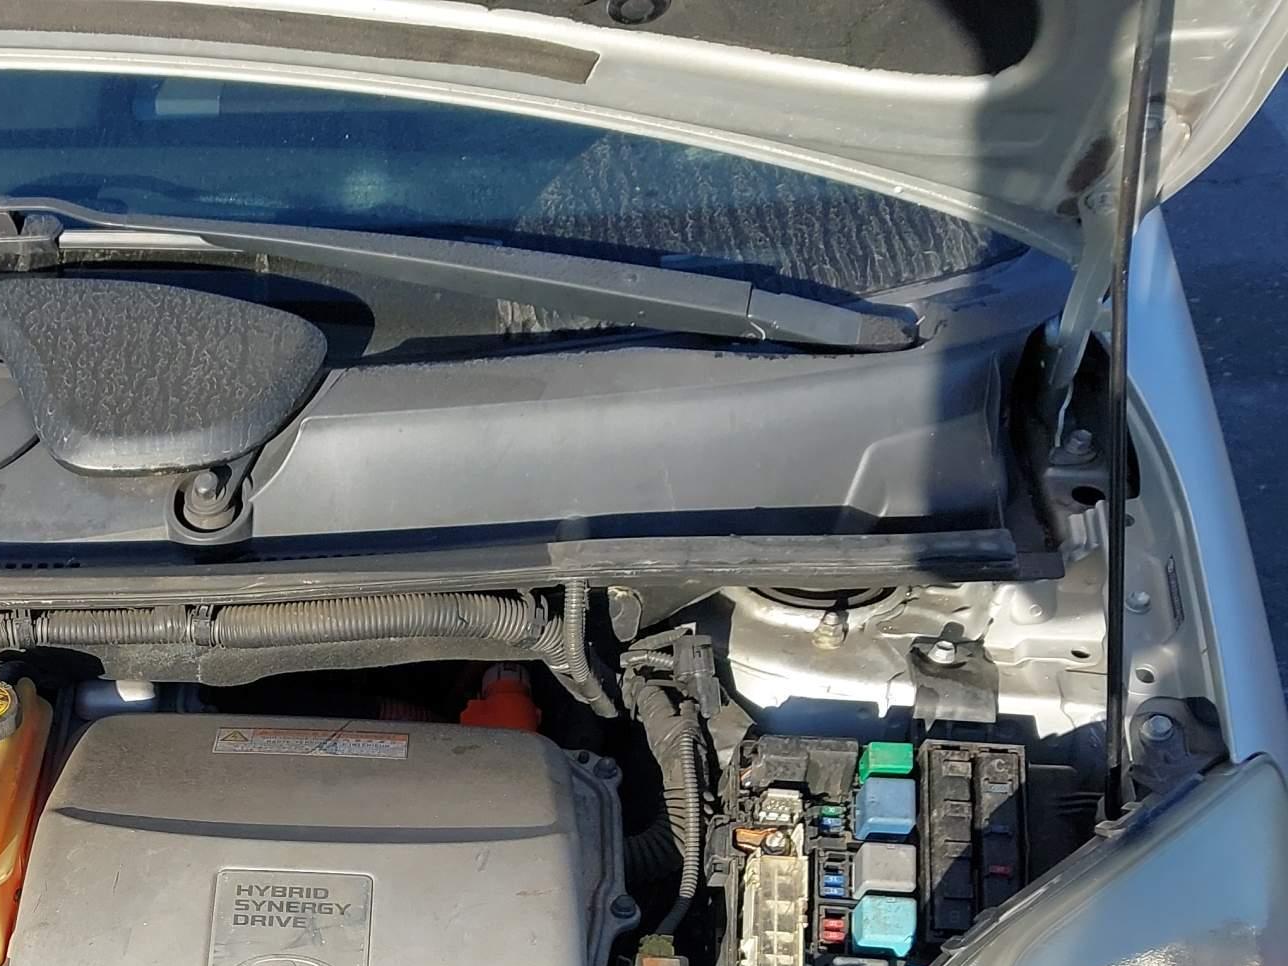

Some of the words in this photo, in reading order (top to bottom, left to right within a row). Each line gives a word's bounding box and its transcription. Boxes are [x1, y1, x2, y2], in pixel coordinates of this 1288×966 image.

[236, 884, 330, 900] HYBRID
[234, 899, 352, 916] SYNERGY
[232, 914, 307, 929] DRIVE
